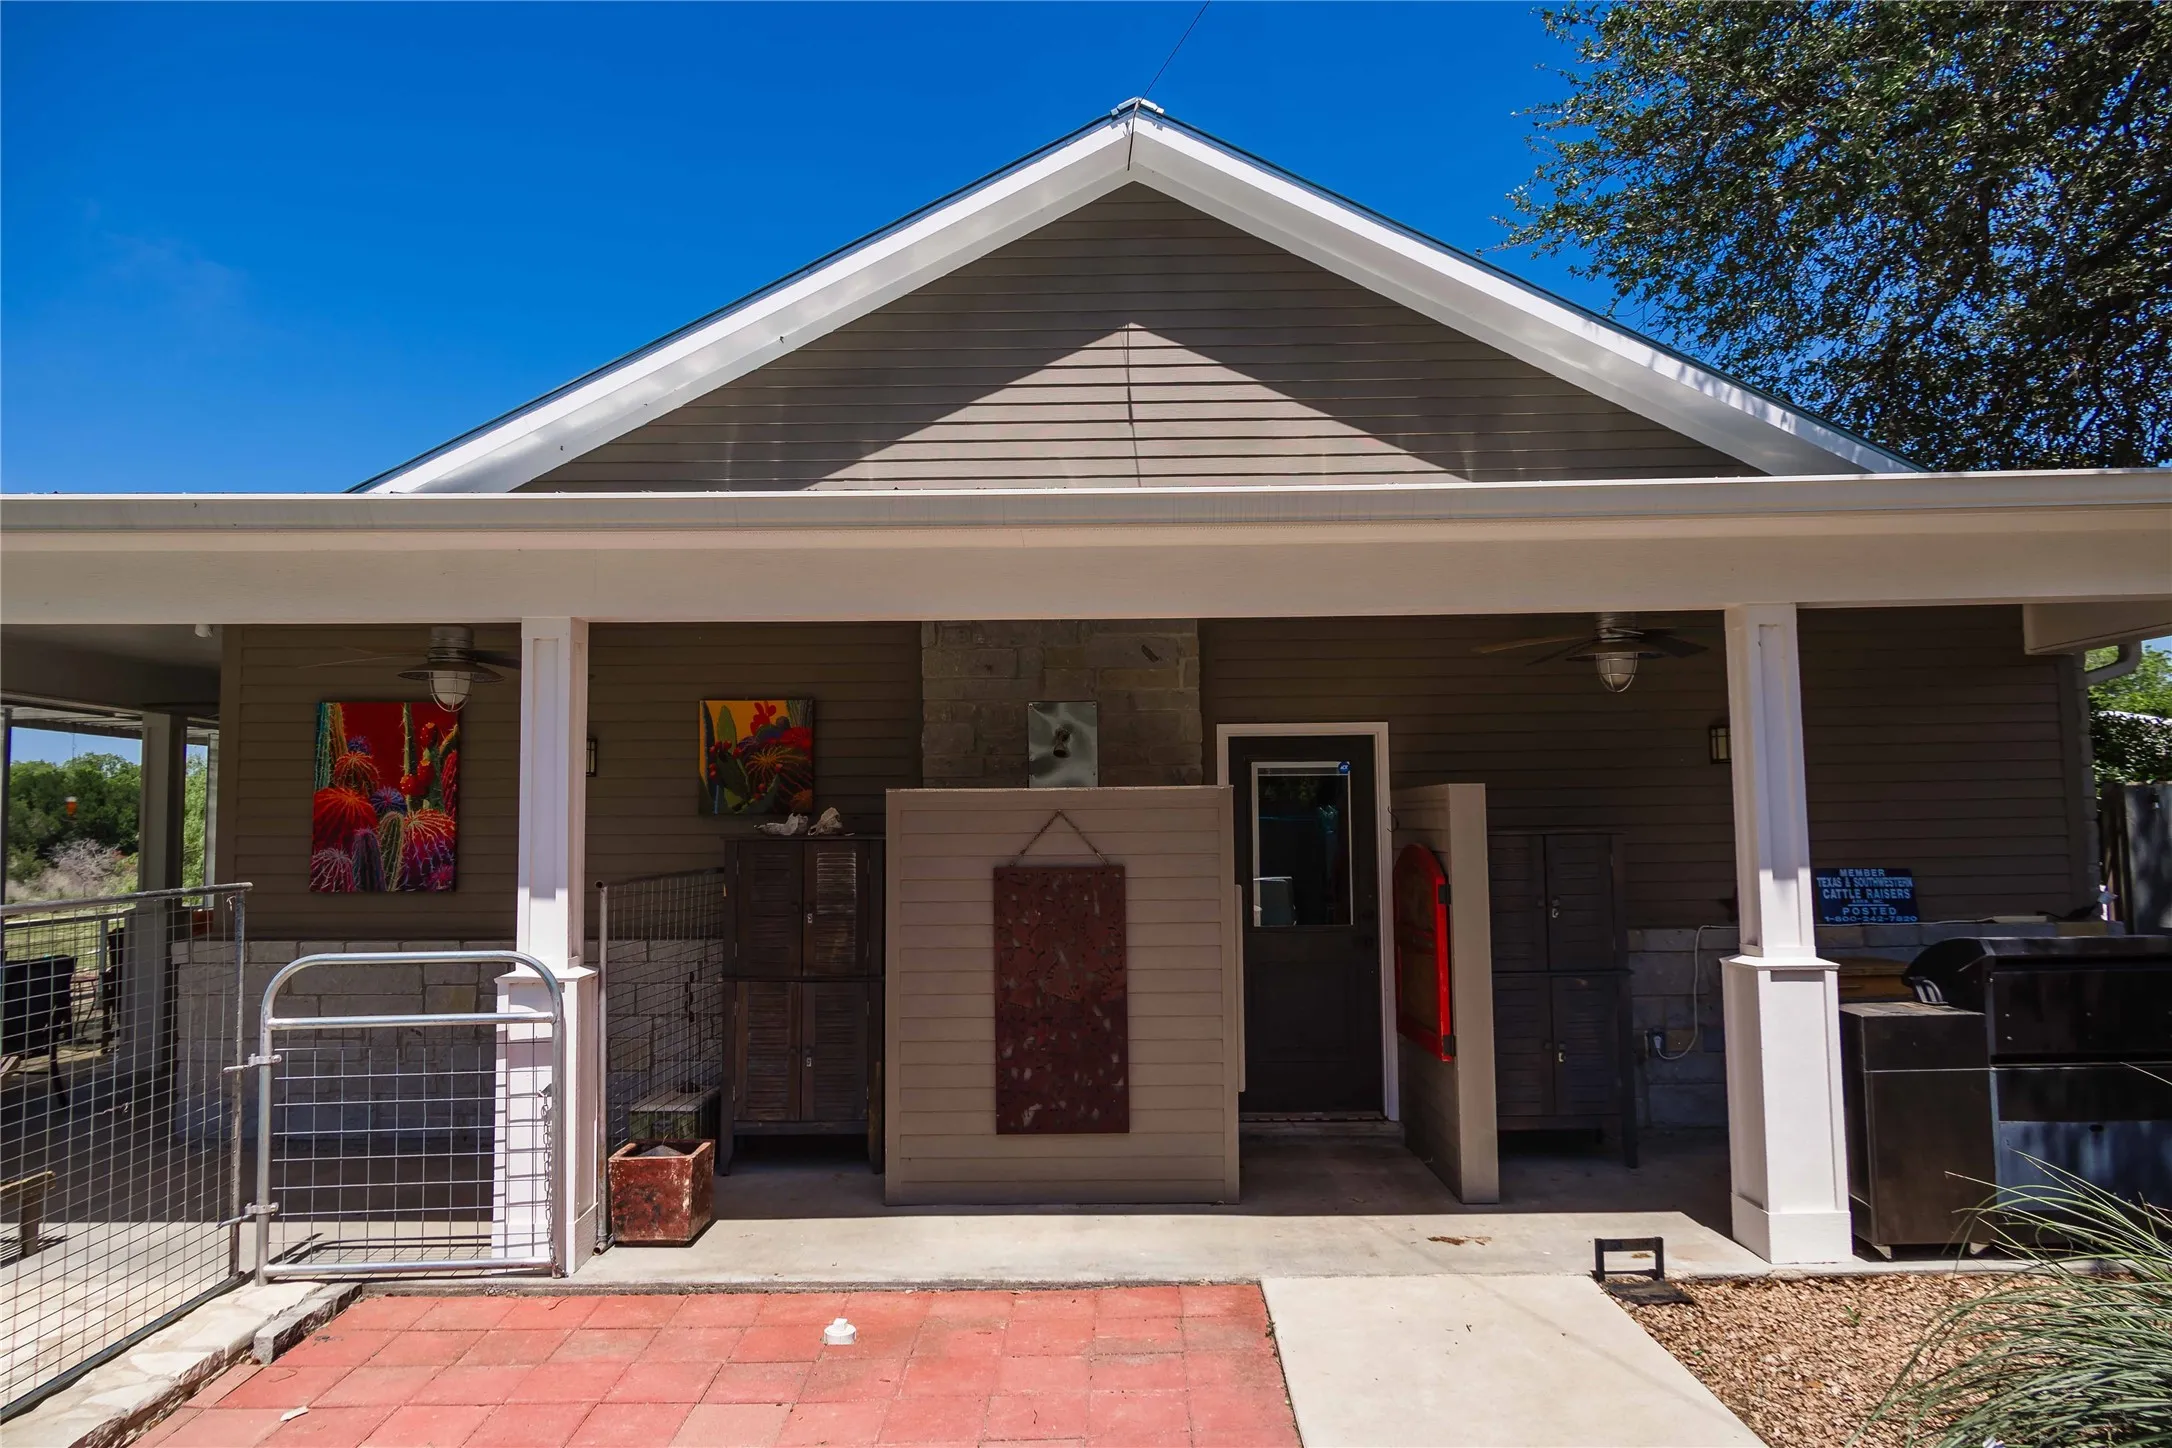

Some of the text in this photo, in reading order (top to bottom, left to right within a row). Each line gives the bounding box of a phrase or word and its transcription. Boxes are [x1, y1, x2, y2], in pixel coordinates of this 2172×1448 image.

[1839, 869, 1885, 877] MEMBER
[1816, 877, 1842, 887] TEXAS
[1853, 877, 1913, 887] SOUTHWESTERN
[1823, 888, 1911, 899] CATTLE RAISERS
[1842, 907, 1897, 915] POSTED
